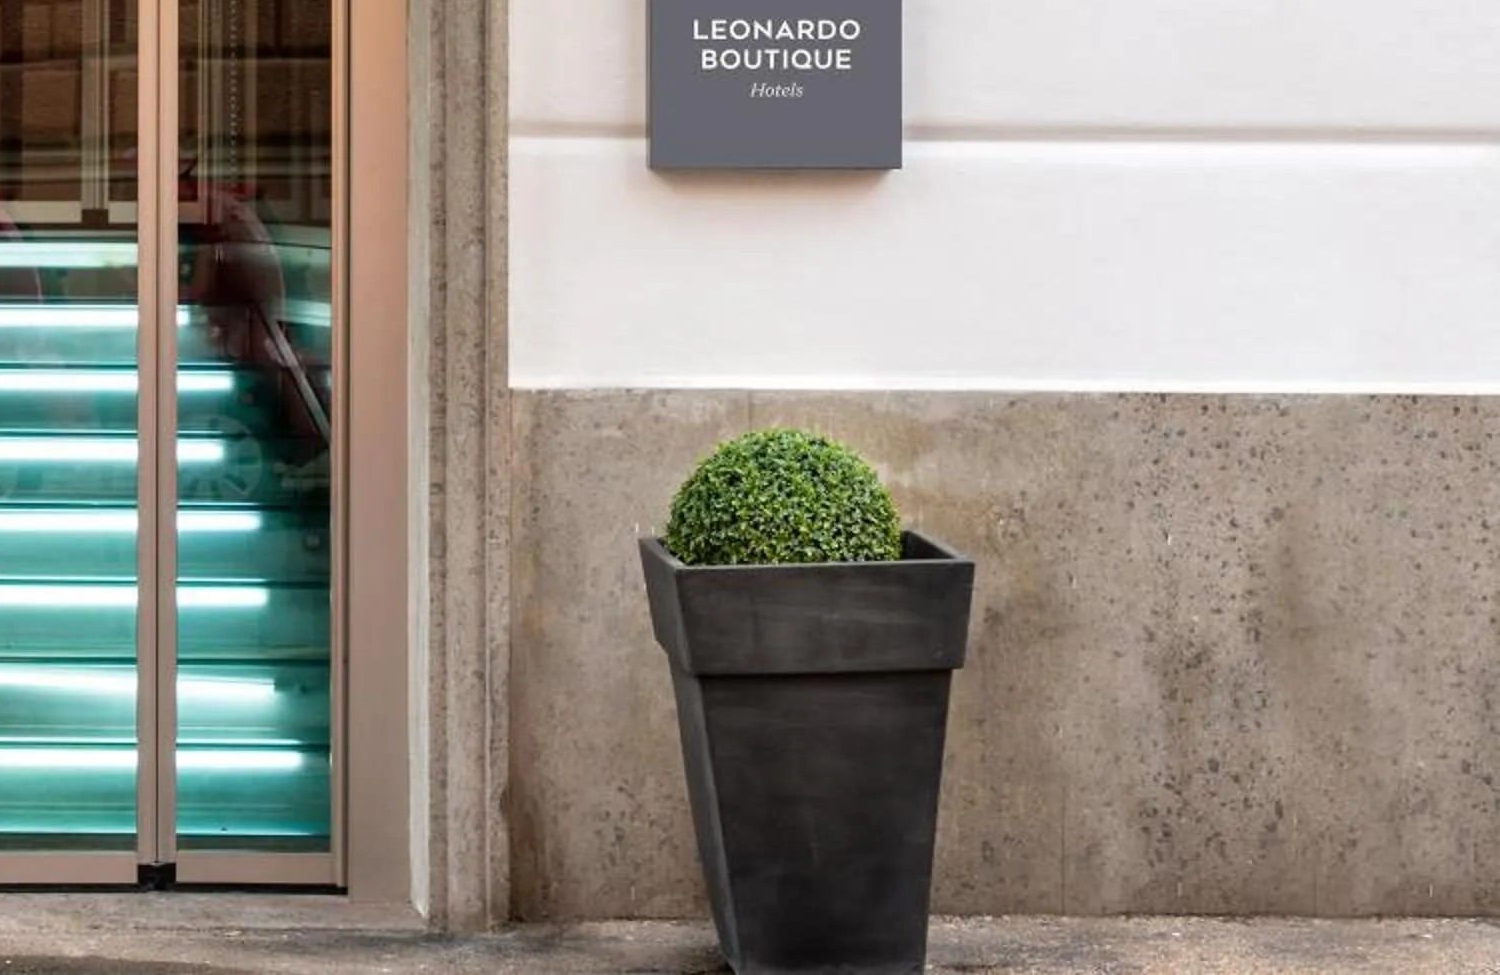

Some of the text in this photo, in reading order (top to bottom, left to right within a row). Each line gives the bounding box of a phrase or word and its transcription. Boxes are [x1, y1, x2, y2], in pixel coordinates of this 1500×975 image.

[693, 19, 861, 40] LEONARDO
[701, 49, 852, 70] BOUTIQUE
[750, 82, 804, 98] Hotels
